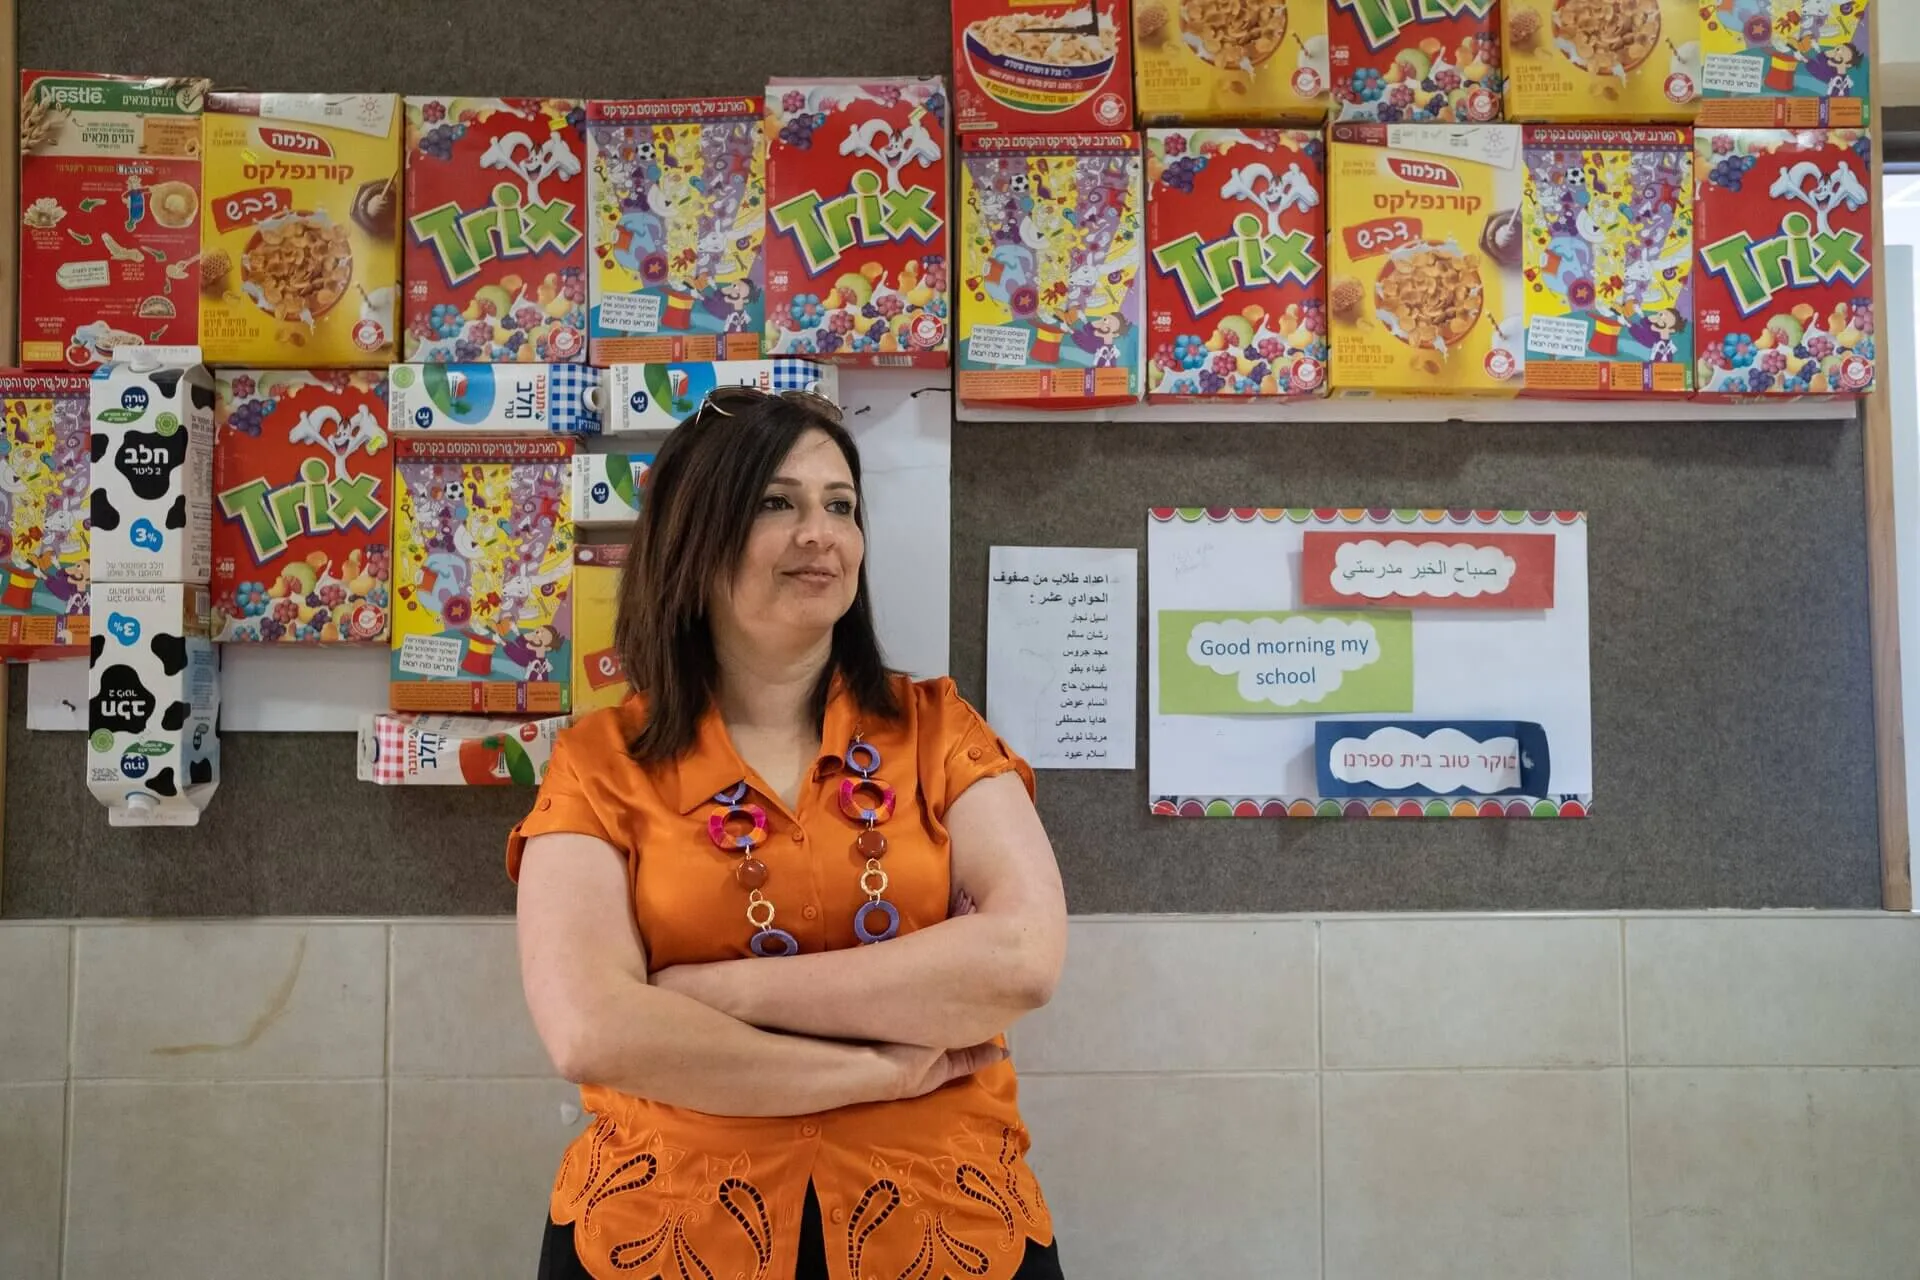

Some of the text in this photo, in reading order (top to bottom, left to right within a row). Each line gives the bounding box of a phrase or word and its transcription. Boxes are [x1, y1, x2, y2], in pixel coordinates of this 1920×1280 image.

[122, 95, 174, 107] דגנים מלאים
[603, 100, 747, 118] הארנב של טריקס והקוסם בקרקס
[82, 132, 135, 144] דגנים מלאים
[272, 132, 320, 150] תלמה
[979, 135, 1121, 150] הארנב של טריקס והקוסם בקרקס
[1534, 129, 1676, 143] הארנב של טריקס והקוסם בקרקס
[243, 160, 355, 185] קורנפלקס
[1400, 161, 1447, 182] תלמה
[225, 192, 278, 220] דבש
[1373, 189, 1482, 213] קורנפלקס
[769, 169, 944, 276] Trix
[409, 182, 584, 286] Trix
[1357, 223, 1408, 250] דבש
[1152, 213, 1321, 316] Trix
[1699, 212, 1870, 316] Trix
[23, 376, 54, 391] טריקס
[124, 393, 146, 404] טרה
[516, 381, 535, 419] חלב
[536, 374, 546, 410] תנובה
[504, 401, 515, 419] טרי
[124, 444, 169, 464] חלב
[413, 441, 557, 456] הארנב של טריקס והקוסם בקרקס
[132, 466, 153, 475] ליטר
[217, 457, 388, 565] Trix
[135, 529, 158, 544] 3%
[993, 571, 1030, 585] صفوف
[1051, 572, 1079, 586] طلاب
[1342, 560, 1497, 583] صباح الخير مدرستي
[1033, 574, 1049, 586] من
[1039, 592, 1063, 605] عشر
[1068, 592, 1109, 606] الحوادي
[113, 621, 136, 637] 3%
[1200, 636, 1369, 656] Good morning my
[1256, 667, 1316, 685] school
[117, 689, 138, 697] ליטר
[1061, 681, 1108, 692] ياسمين حاج
[101, 700, 146, 721] חלב
[1055, 714, 1086, 727] مصطفى
[408, 739, 418, 775] תנובה
[421, 733, 437, 769] חלב
[1087, 749, 1107, 760] اسلام
[123, 761, 146, 771] טרה
[1343, 752, 1394, 768] ספרנו
[1400, 754, 1432, 768] בית
[1439, 754, 1470, 768] טוב
